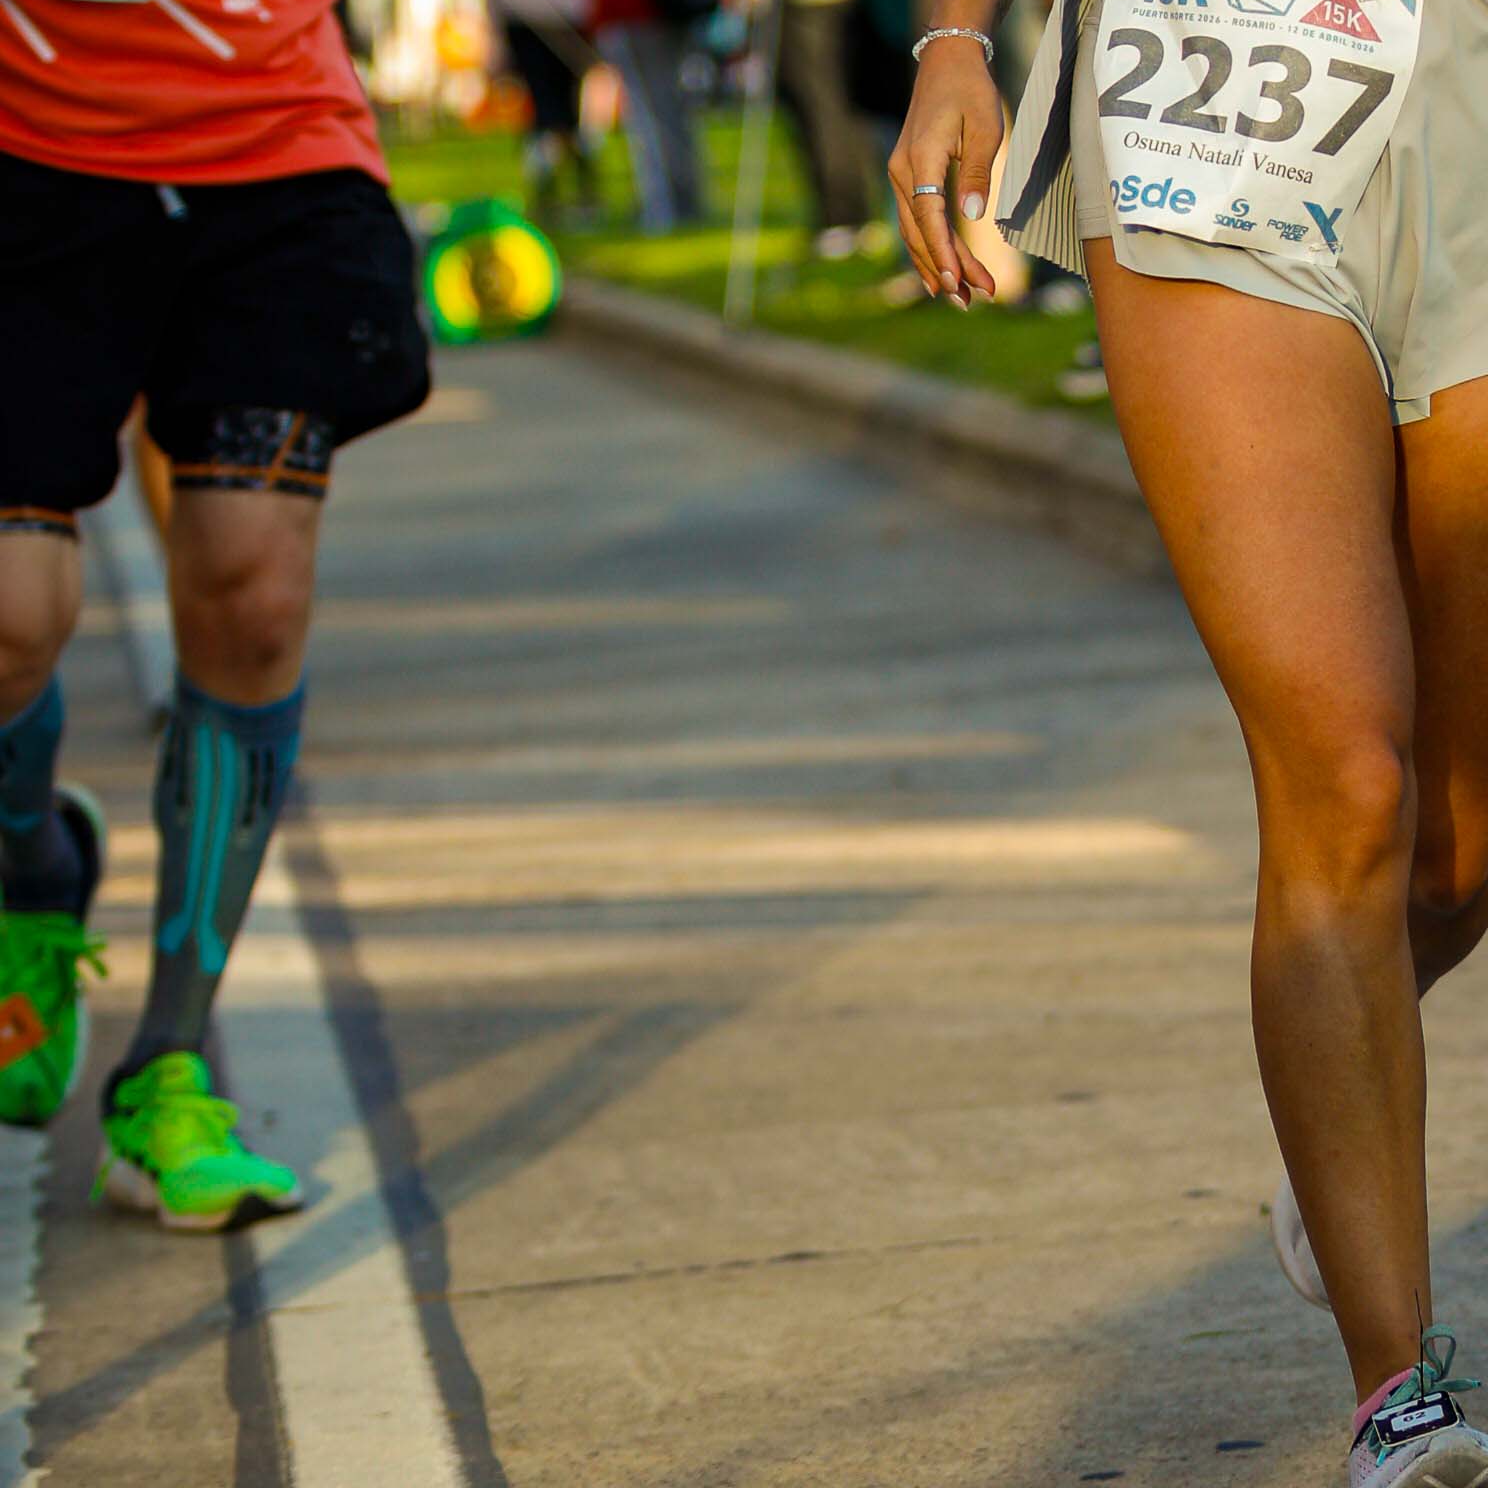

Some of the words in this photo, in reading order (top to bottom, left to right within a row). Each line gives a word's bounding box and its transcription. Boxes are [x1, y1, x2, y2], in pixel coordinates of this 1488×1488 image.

[1132, 8, 1168, 20] PUERTO
[1170, 13, 1195, 22] NORTE
[1198, 14, 1221, 24] 2026
[1232, 18, 1276, 31] ROSARIO
[1287, 25, 1298, 34] 12
[1302, 28, 1315, 38] DE
[1319, 32, 1347, 46] ABRIL
[1351, 41, 1375, 53] 2026
[1323, 0, 1363, 32] 15K
[1097, 27, 1395, 156] 2237
[1123, 131, 1181, 157] Osuna
[1188, 142, 1245, 167] Natali
[1252, 152, 1314, 184] Vanesa
[1267, 219, 1309, 235] POWER
